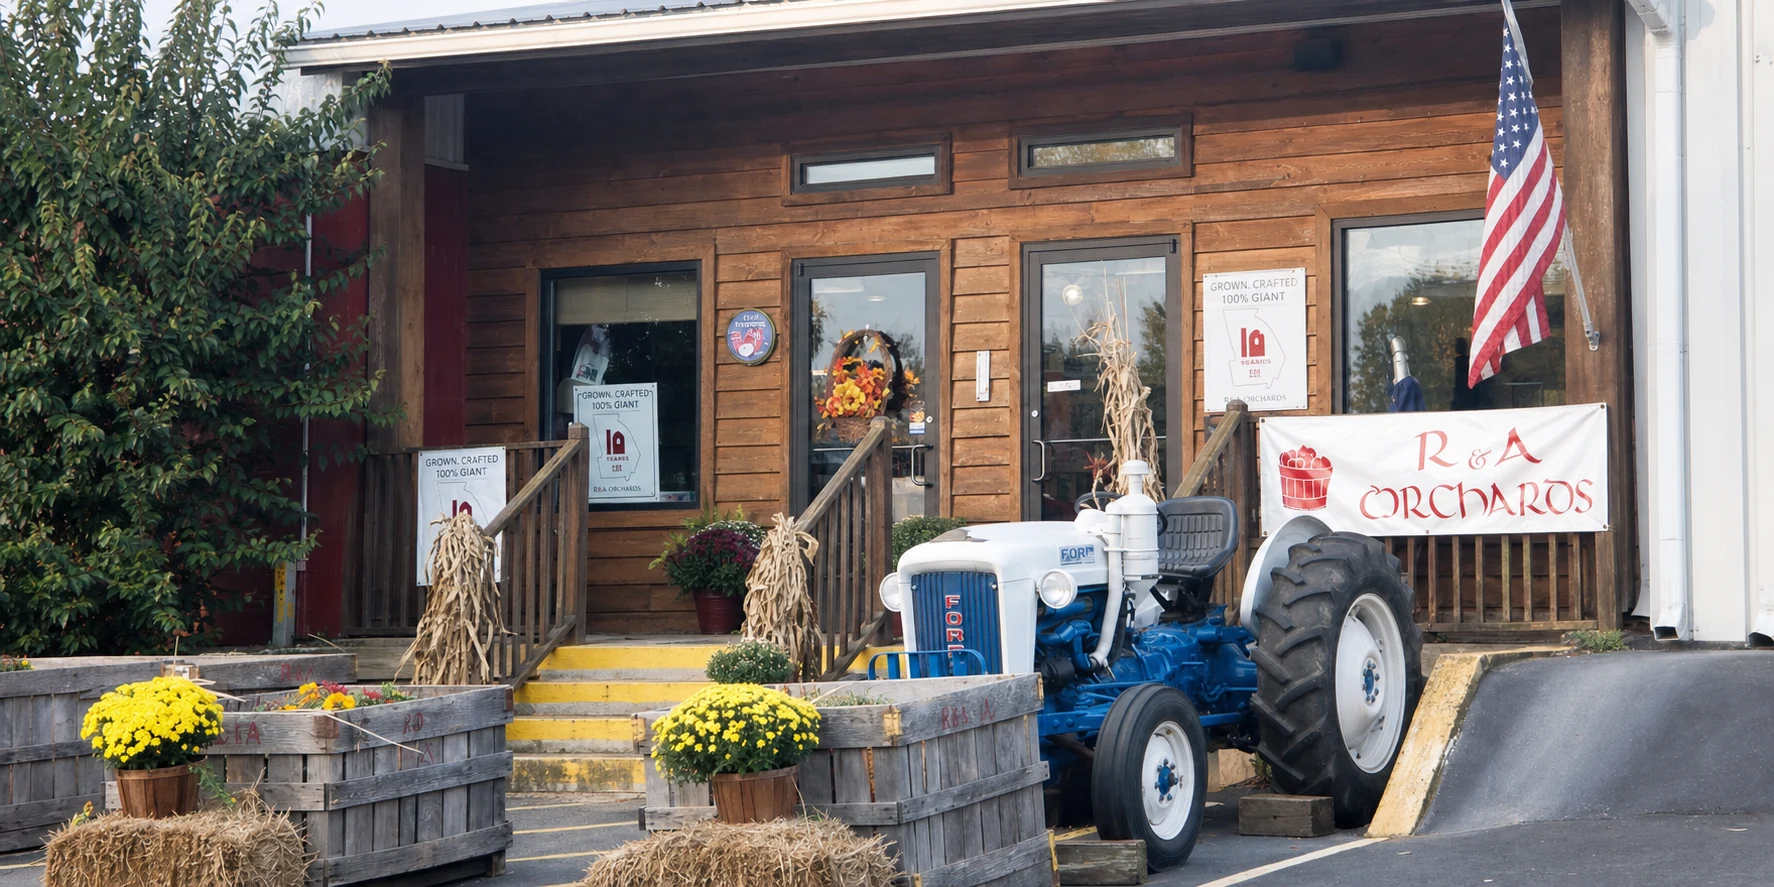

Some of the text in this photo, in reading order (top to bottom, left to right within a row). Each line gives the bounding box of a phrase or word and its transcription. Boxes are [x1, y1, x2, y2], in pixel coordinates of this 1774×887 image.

[1252, 277, 1298, 289] CRAFTED
[1222, 292, 1286, 304] 100% GIANT
[614, 389, 650, 398] CRAFTED
[1243, 394, 1287, 403] ORCHARDS
[592, 400, 639, 410] 100% GIANT
[1415, 426, 1543, 471] R & A
[461, 455, 499, 465] CRAFTED
[436, 467, 487, 478] 100% GIANT
[1359, 478, 1594, 520] ORCHARDS
